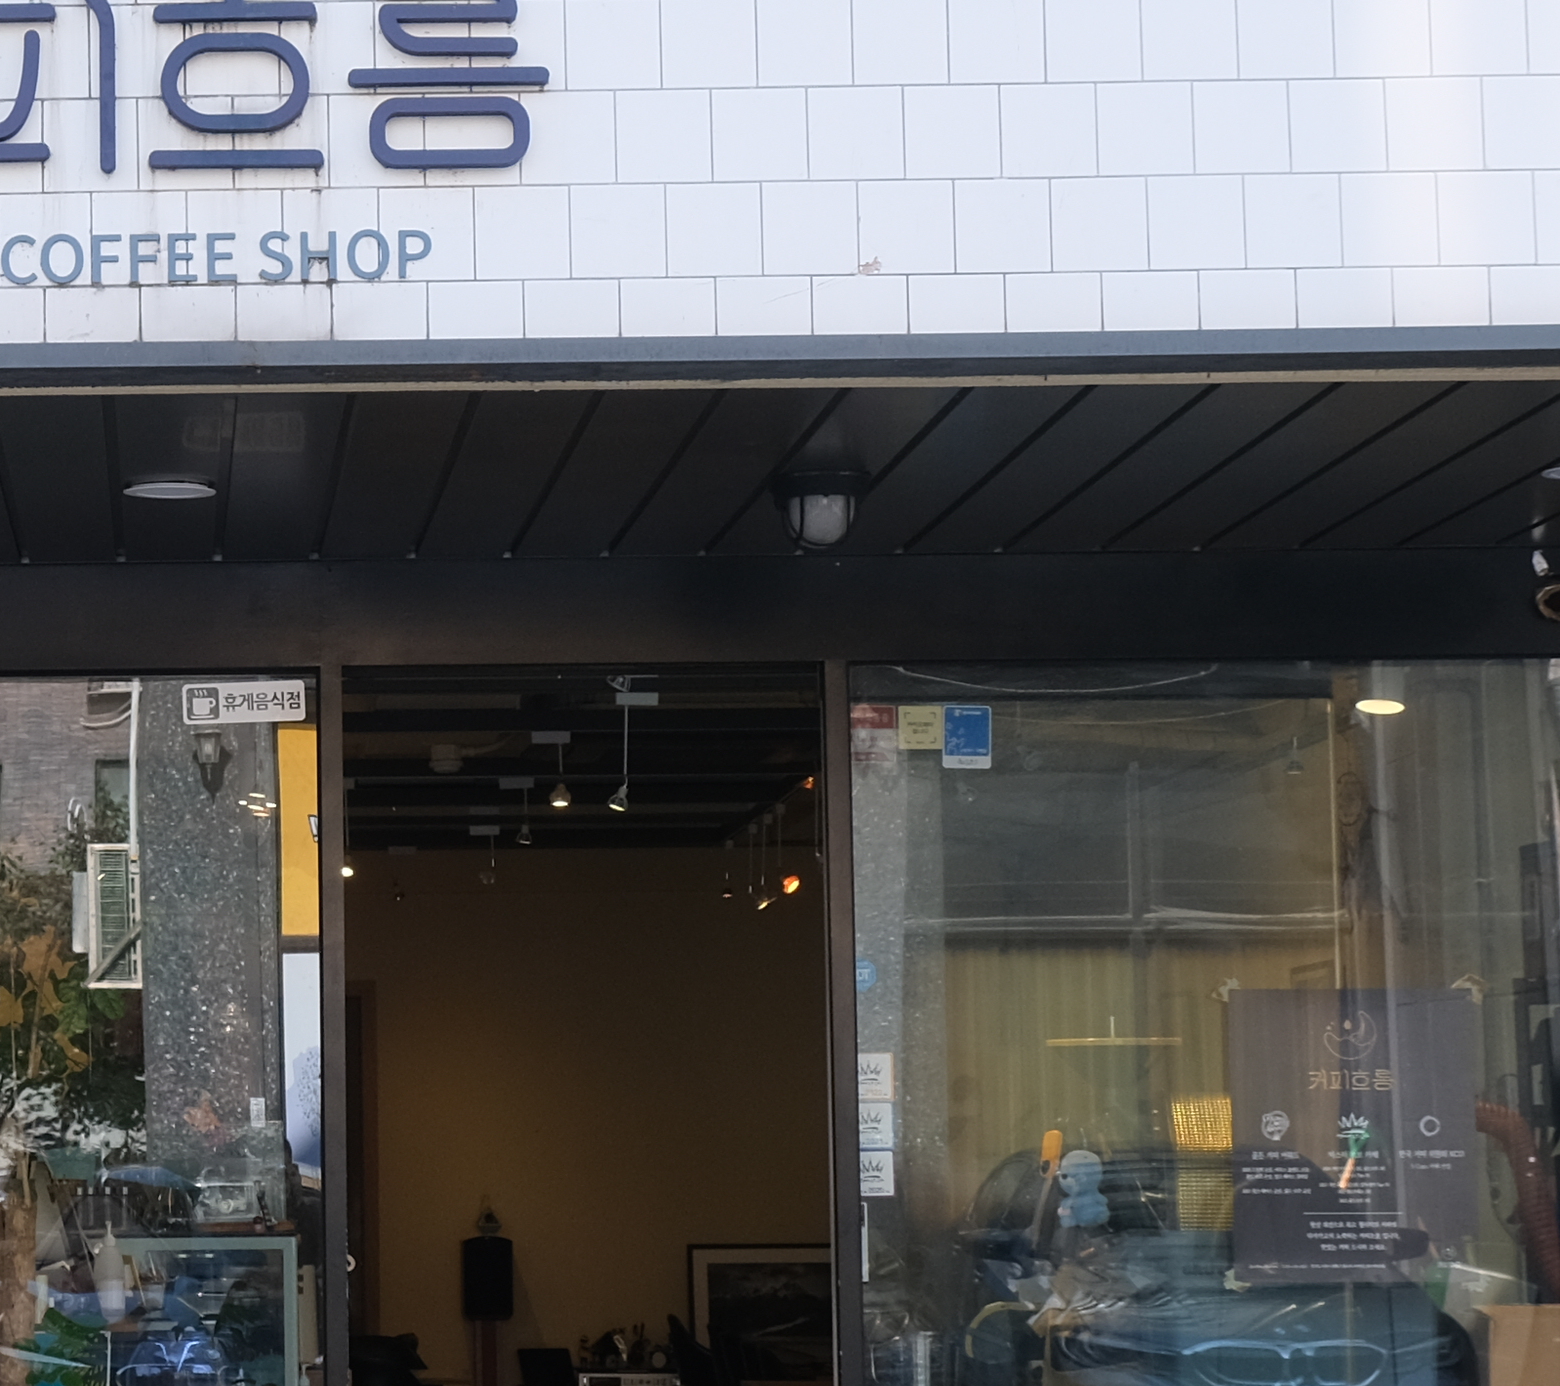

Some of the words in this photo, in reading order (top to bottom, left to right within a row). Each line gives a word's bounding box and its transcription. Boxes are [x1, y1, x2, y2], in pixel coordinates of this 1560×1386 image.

[0, 231, 238, 286] COFFEE
[258, 226, 433, 282] SHOP
[222, 691, 301, 712] 휴게음식점
[1307, 1069, 1395, 1091] 커피흐름
